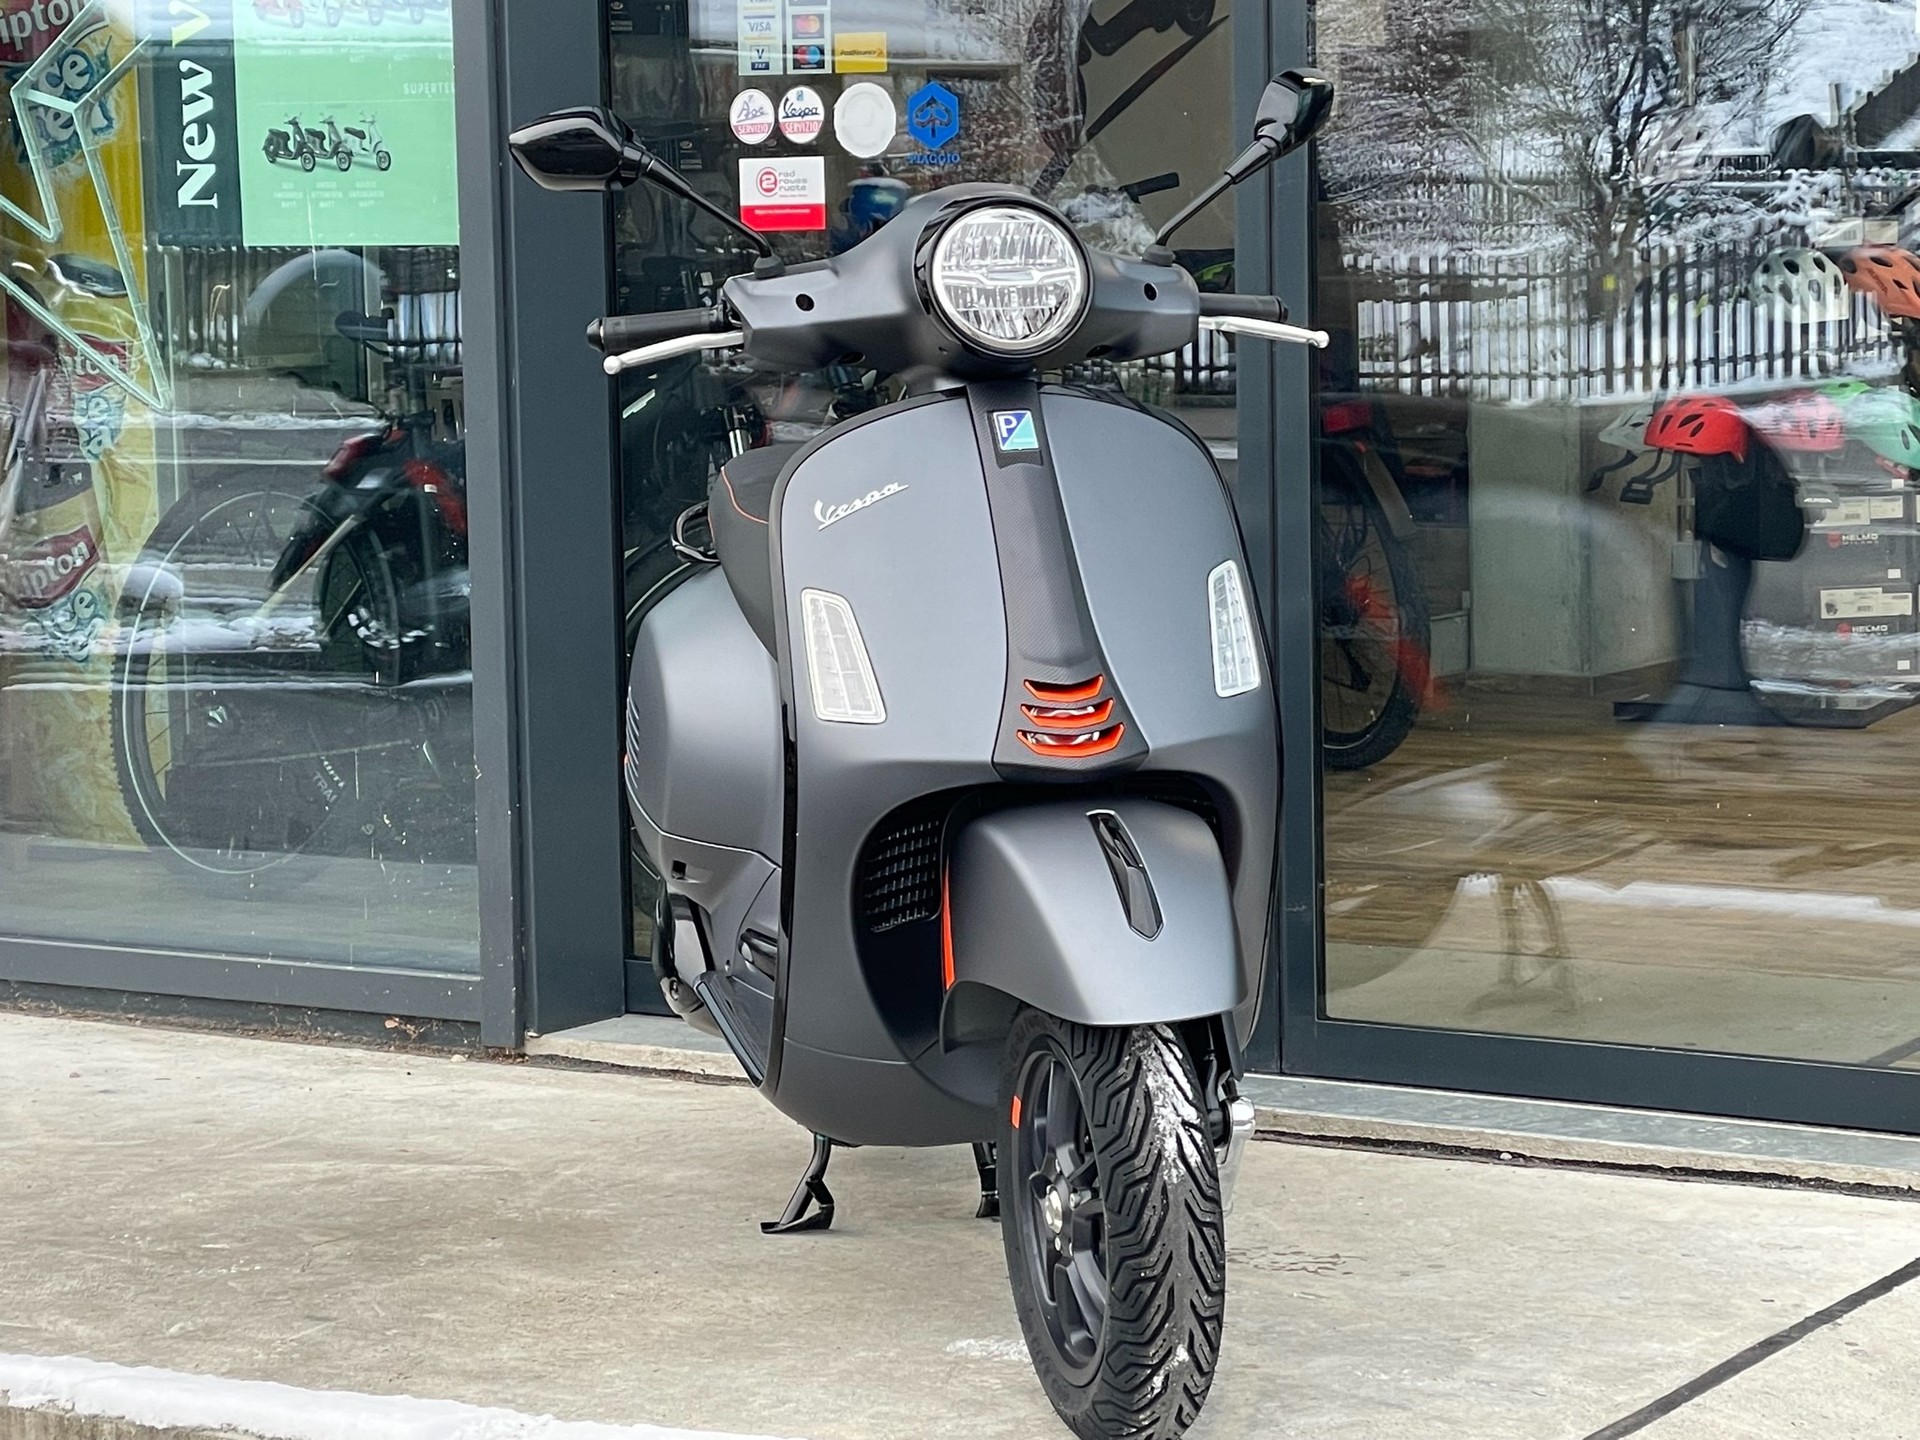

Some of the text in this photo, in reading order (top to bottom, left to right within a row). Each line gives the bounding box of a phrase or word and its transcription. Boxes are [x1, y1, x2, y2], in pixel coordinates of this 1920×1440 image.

[749, 22, 771, 32] VISA
[782, 97, 821, 119] Vespa
[176, 59, 218, 209] New
[738, 124, 769, 134] SERVIZIO
[785, 121, 819, 133] SERVIZIO
[909, 153, 960, 164] PIAGGIO
[998, 415, 1018, 437] P
[814, 482, 910, 532] Vespa
